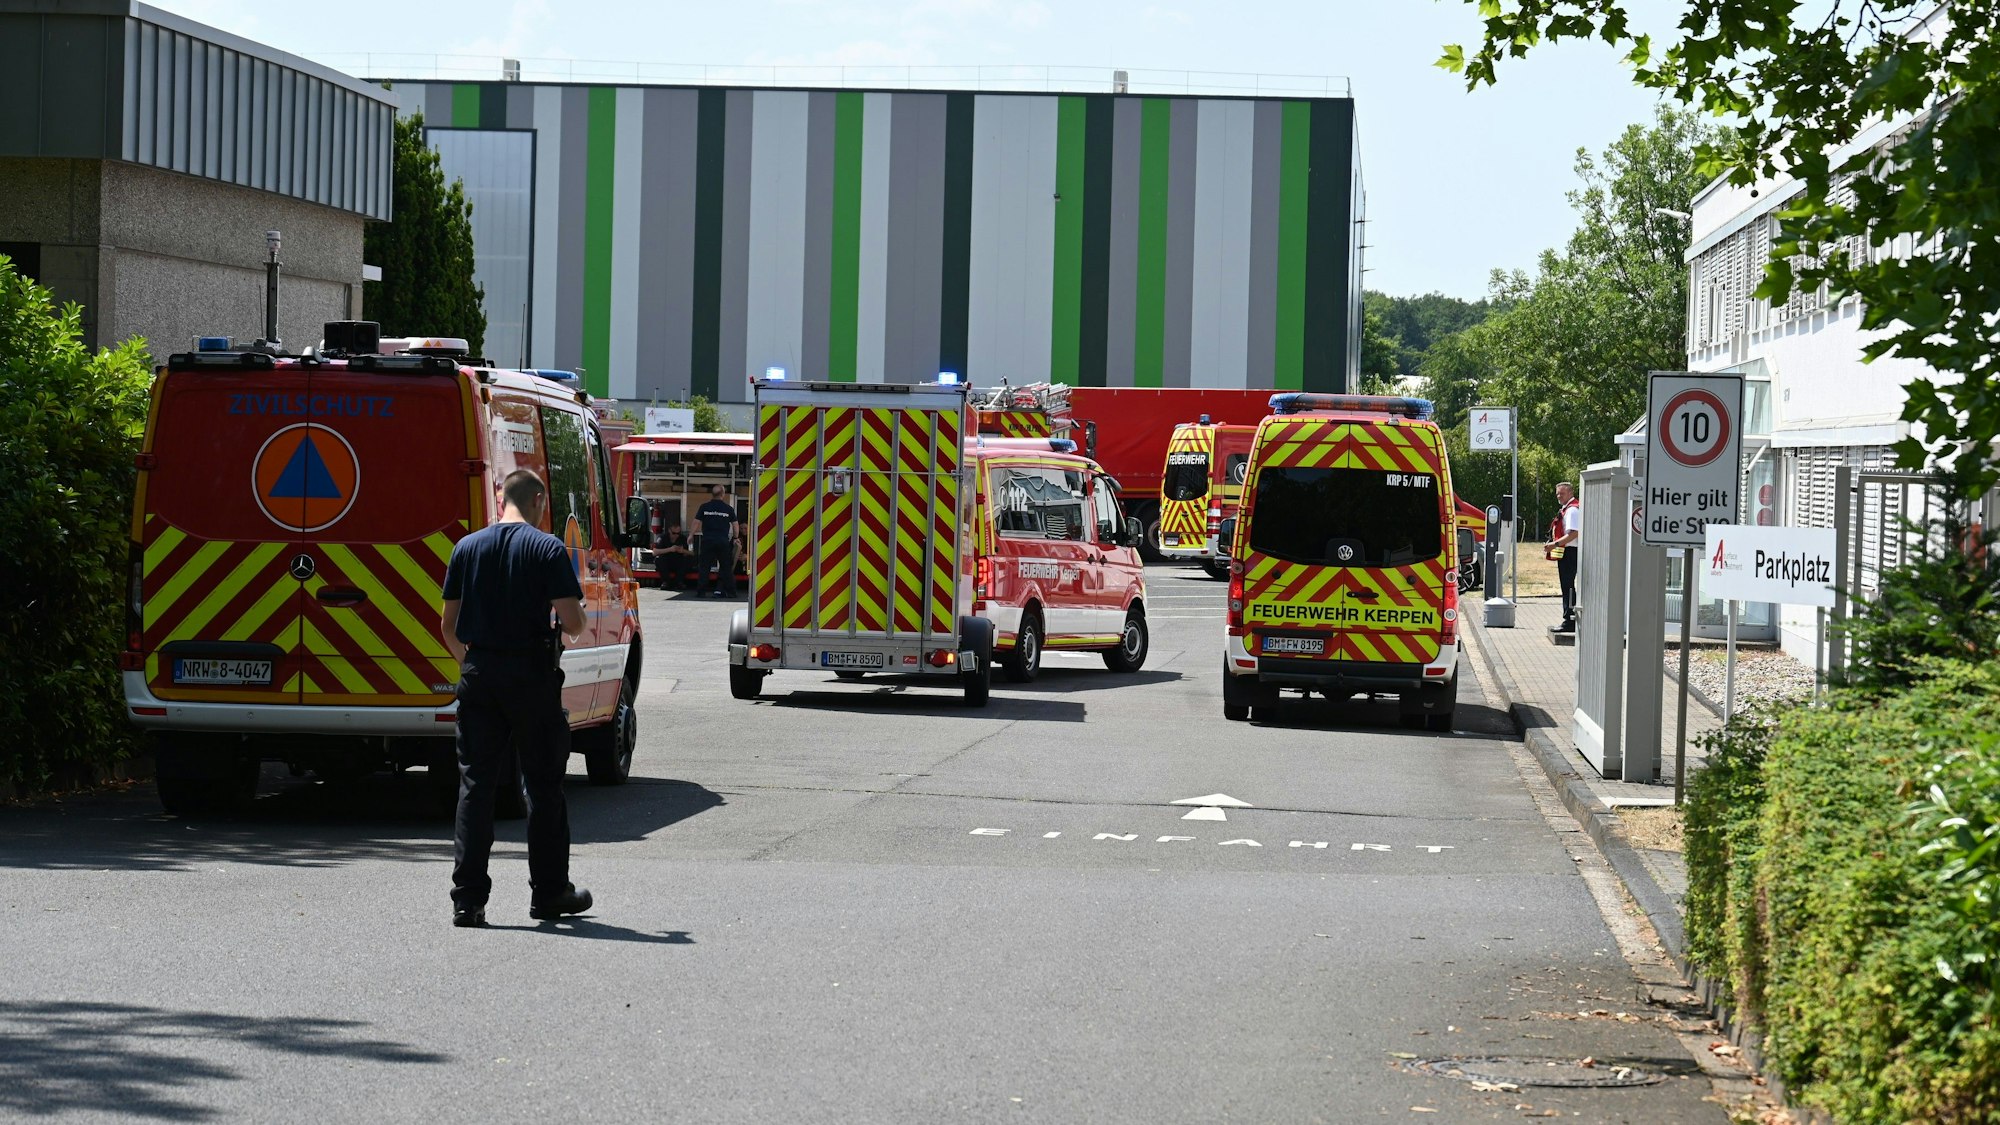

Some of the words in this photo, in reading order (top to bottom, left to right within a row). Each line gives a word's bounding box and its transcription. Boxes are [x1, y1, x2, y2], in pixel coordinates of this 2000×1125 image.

[229, 394, 394, 416] ZIVILSCHUTZ
[1681, 412, 1710, 443] 10
[1169, 454, 1206, 465] FEUERWEHR
[1386, 474, 1402, 486] KRP
[1402, 475, 1430, 488] 5/MTF
[1009, 487, 1028, 511] 112
[1652, 487, 1692, 506] Hier
[1697, 489, 1728, 511] gilt
[1652, 516, 1680, 534] die
[1018, 561, 1058, 579] FEUERWEHR
[1755, 549, 1830, 588] Parkplatz
[1253, 604, 1359, 621] FEUERWEHR
[1364, 608, 1433, 624] KERPEN
[1268, 638, 1280, 649] BM
[1286, 639, 1299, 650] FW
[1300, 639, 1323, 650] 8195
[828, 653, 840, 664] BM
[846, 654, 858, 664] FW
[859, 655, 881, 665] 8590
[183, 661, 210, 678] NRW
[220, 662, 270, 679] 8-4047
[968, 827, 1455, 853] EINFAHRT
